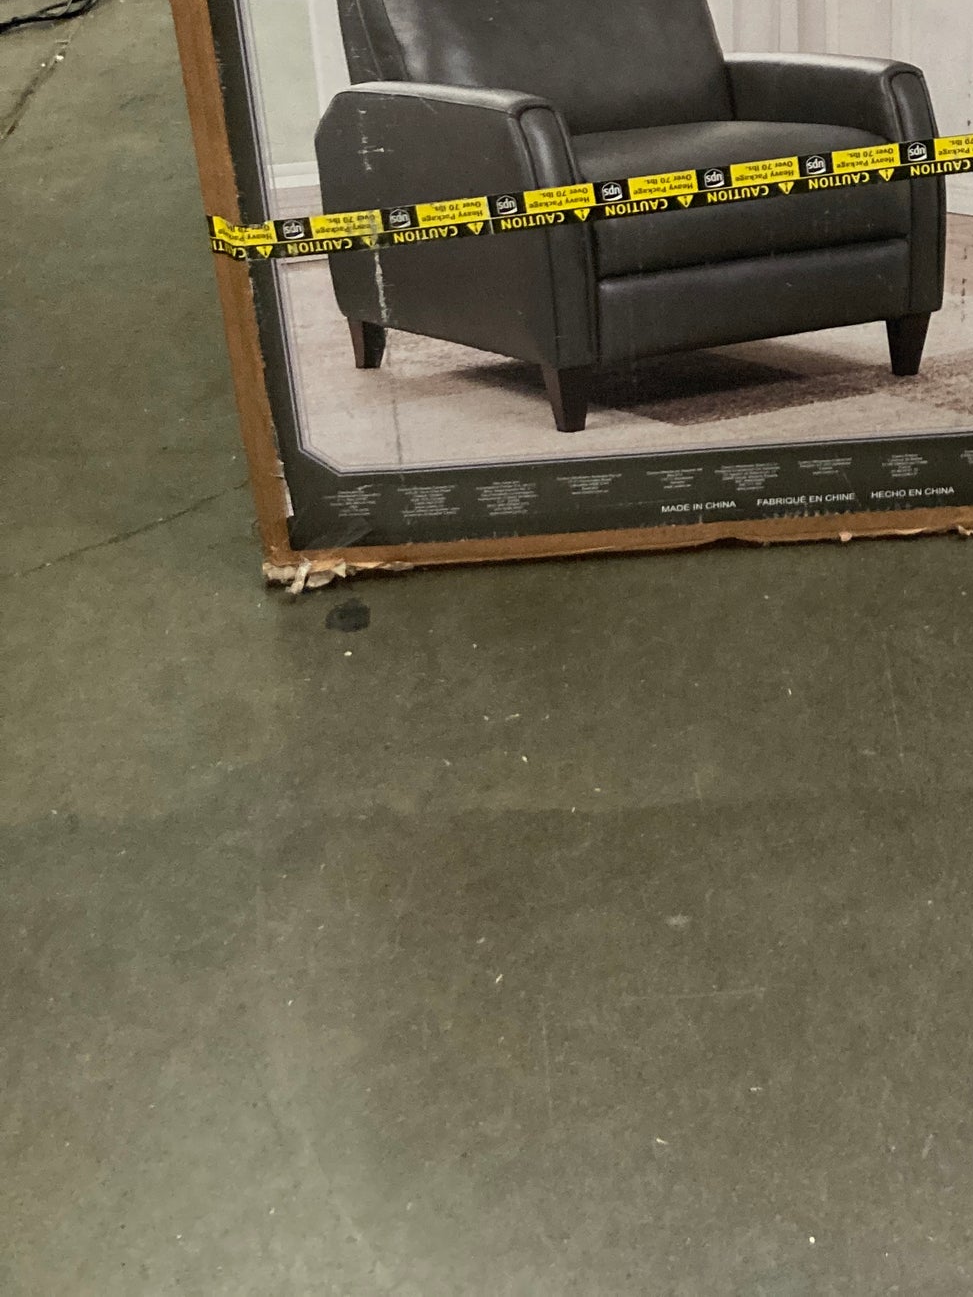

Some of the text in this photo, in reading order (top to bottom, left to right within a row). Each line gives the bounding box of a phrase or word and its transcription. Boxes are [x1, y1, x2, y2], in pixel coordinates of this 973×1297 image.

[761, 162, 773, 170] 70
[773, 160, 793, 169] Over
[734, 168, 795, 182] Heavy Package
[807, 171, 870, 190] CAUTION
[707, 184, 769, 203] CAUTION
[808, 494, 823, 503] EN
[824, 492, 856, 503] CHINE
[871, 486, 955, 499] HECHO EN CHINA
[661, 499, 737, 514] MADE IN CHINA
